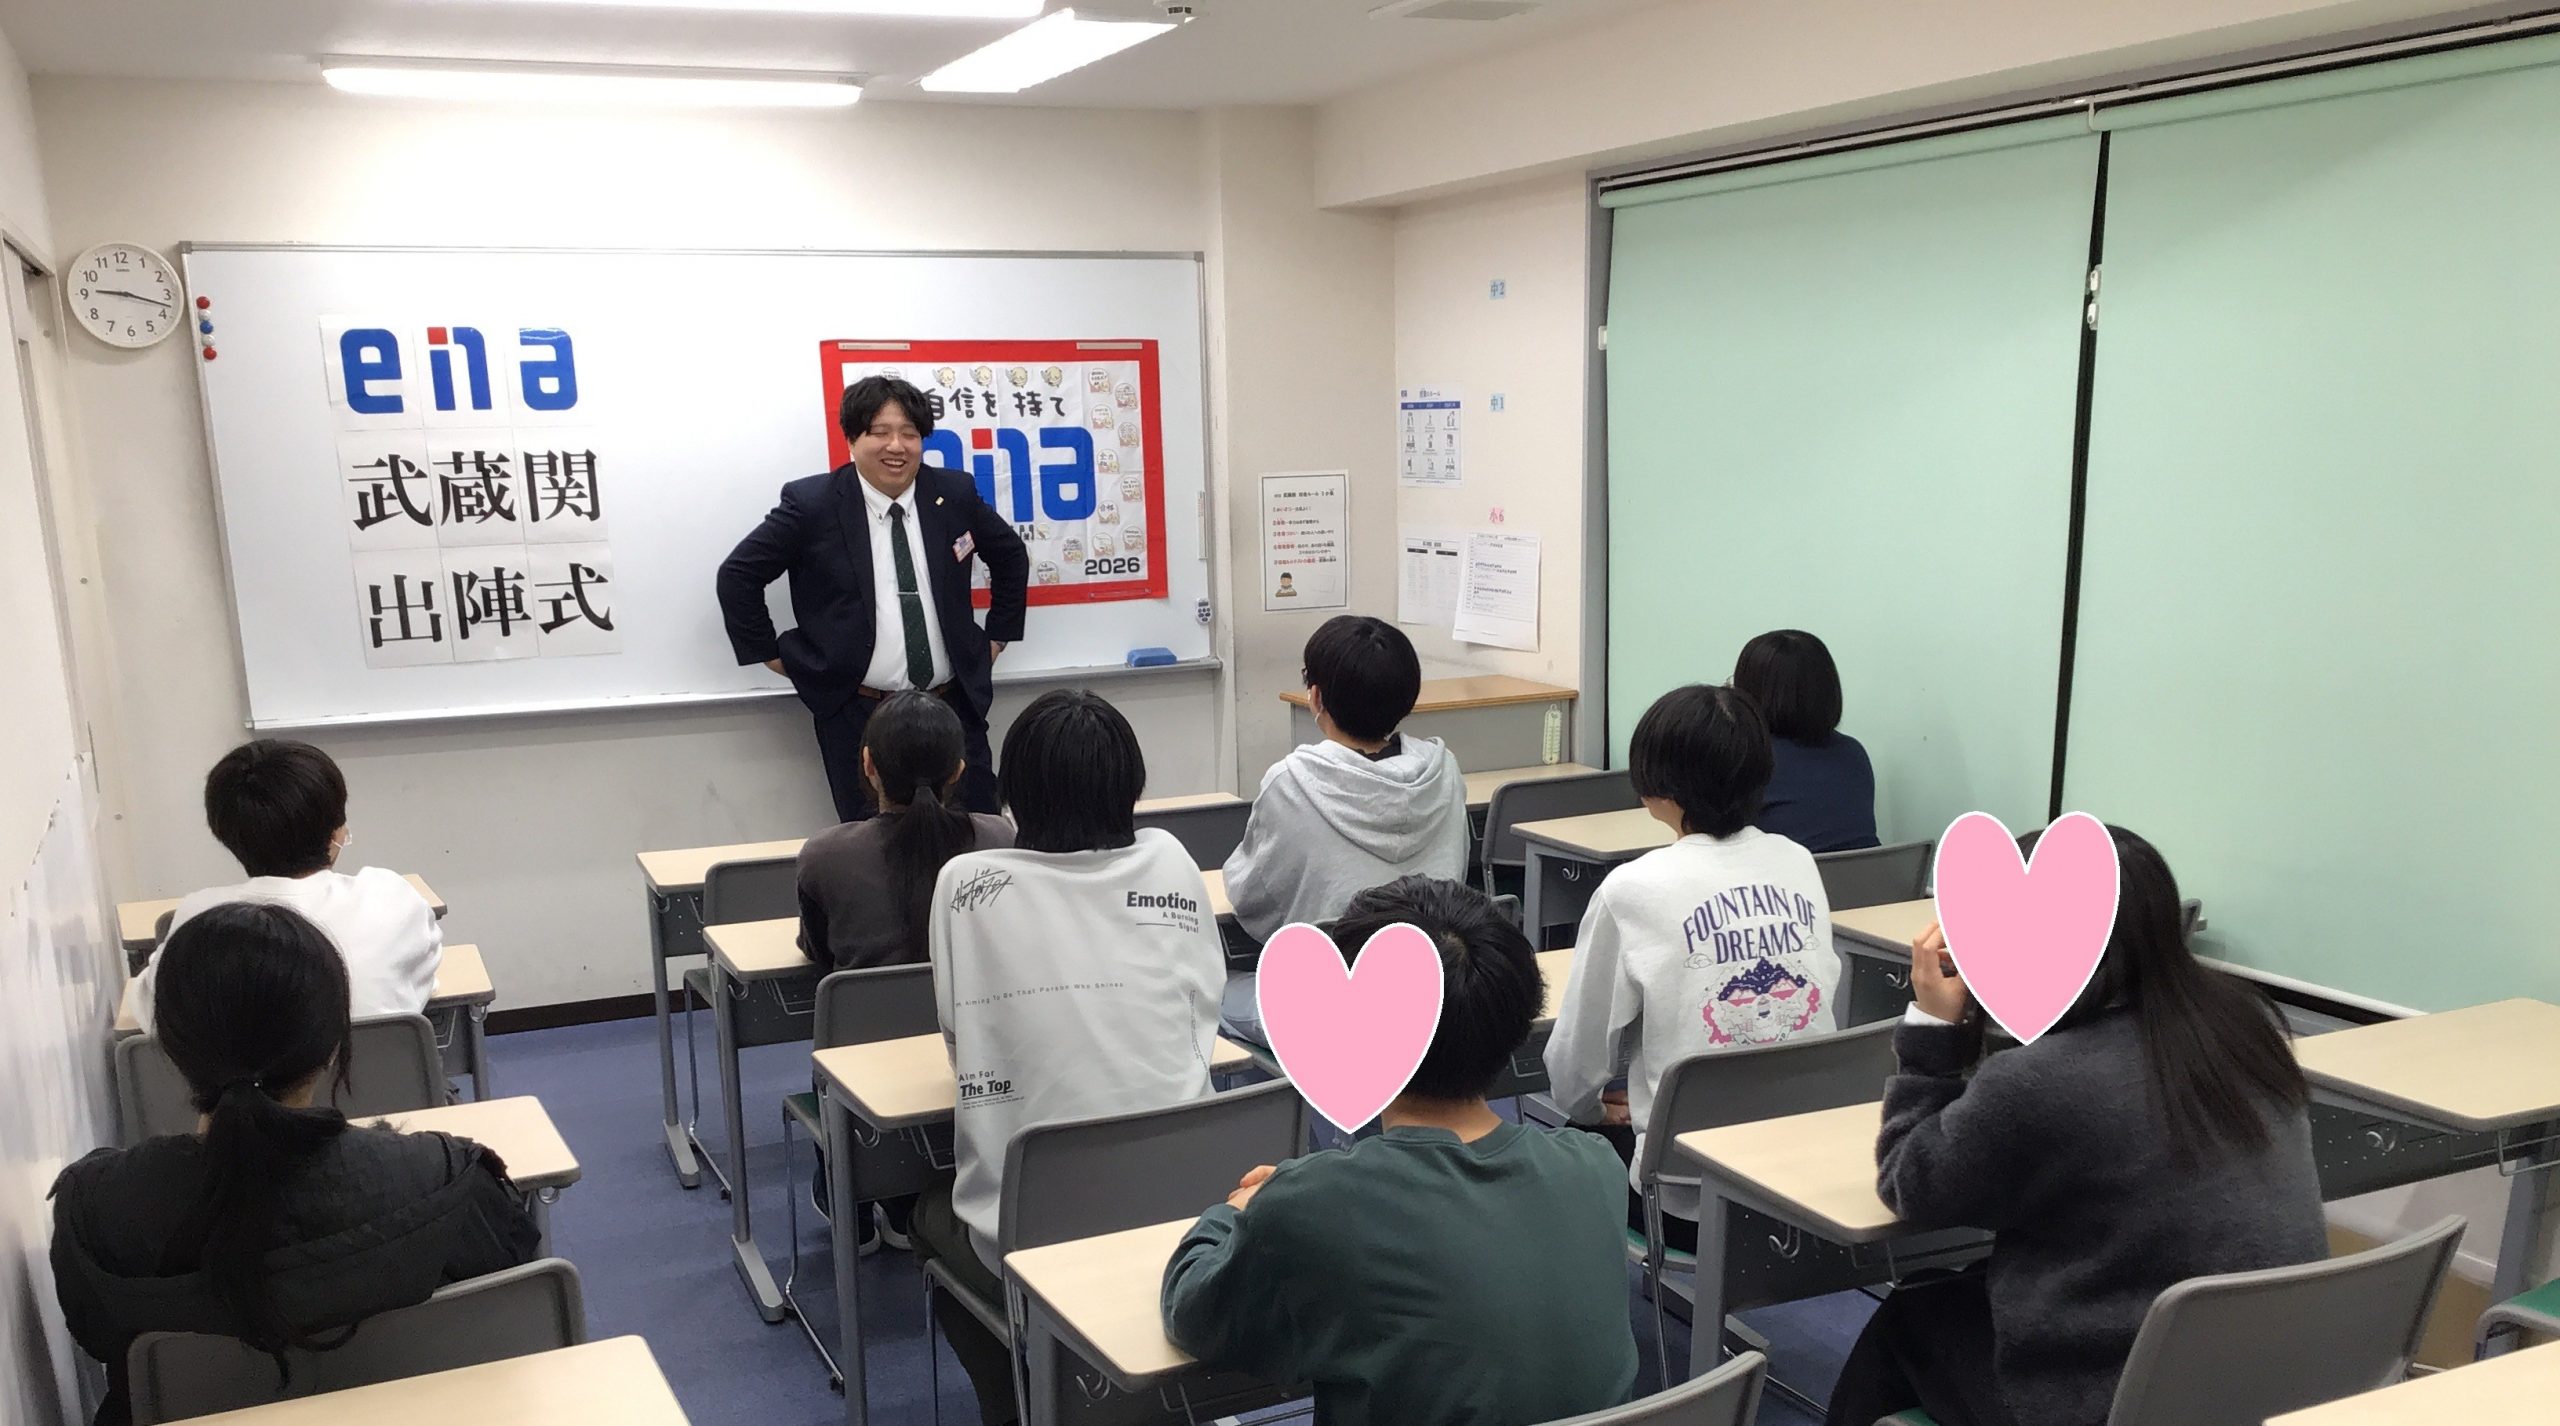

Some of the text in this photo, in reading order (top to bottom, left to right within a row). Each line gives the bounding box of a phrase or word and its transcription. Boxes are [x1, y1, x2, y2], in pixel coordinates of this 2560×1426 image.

[95, 257, 108, 269] 11
[113, 252, 129, 264] 12
[139, 257, 146, 269] 1
[83, 270, 98, 283] 10
[154, 270, 164, 283] 2
[80, 288, 89, 300] 9
[163, 288, 172, 301] 3
[90, 307, 99, 320] 8
[158, 308, 167, 320] 4
[106, 320, 115, 333] 7
[127, 324, 136, 337] 6
[145, 320, 154, 332] 5
[339, 326, 578, 415] ena
[347, 448, 602, 532] 武蔵関
[1084, 556, 1141, 576] 2026
[368, 562, 615, 649] 出陣式
[1126, 890, 1198, 913] Emotion
[1162, 911, 1199, 925] A Burning
[1682, 883, 1817, 954] FOUNTAIN OF
[1178, 921, 1199, 934] Signal
[1712, 921, 1805, 965] DREAMS
[1016, 988, 1036, 996] That
[979, 1070, 995, 1078] For
[960, 1079, 1011, 1098] The Top
